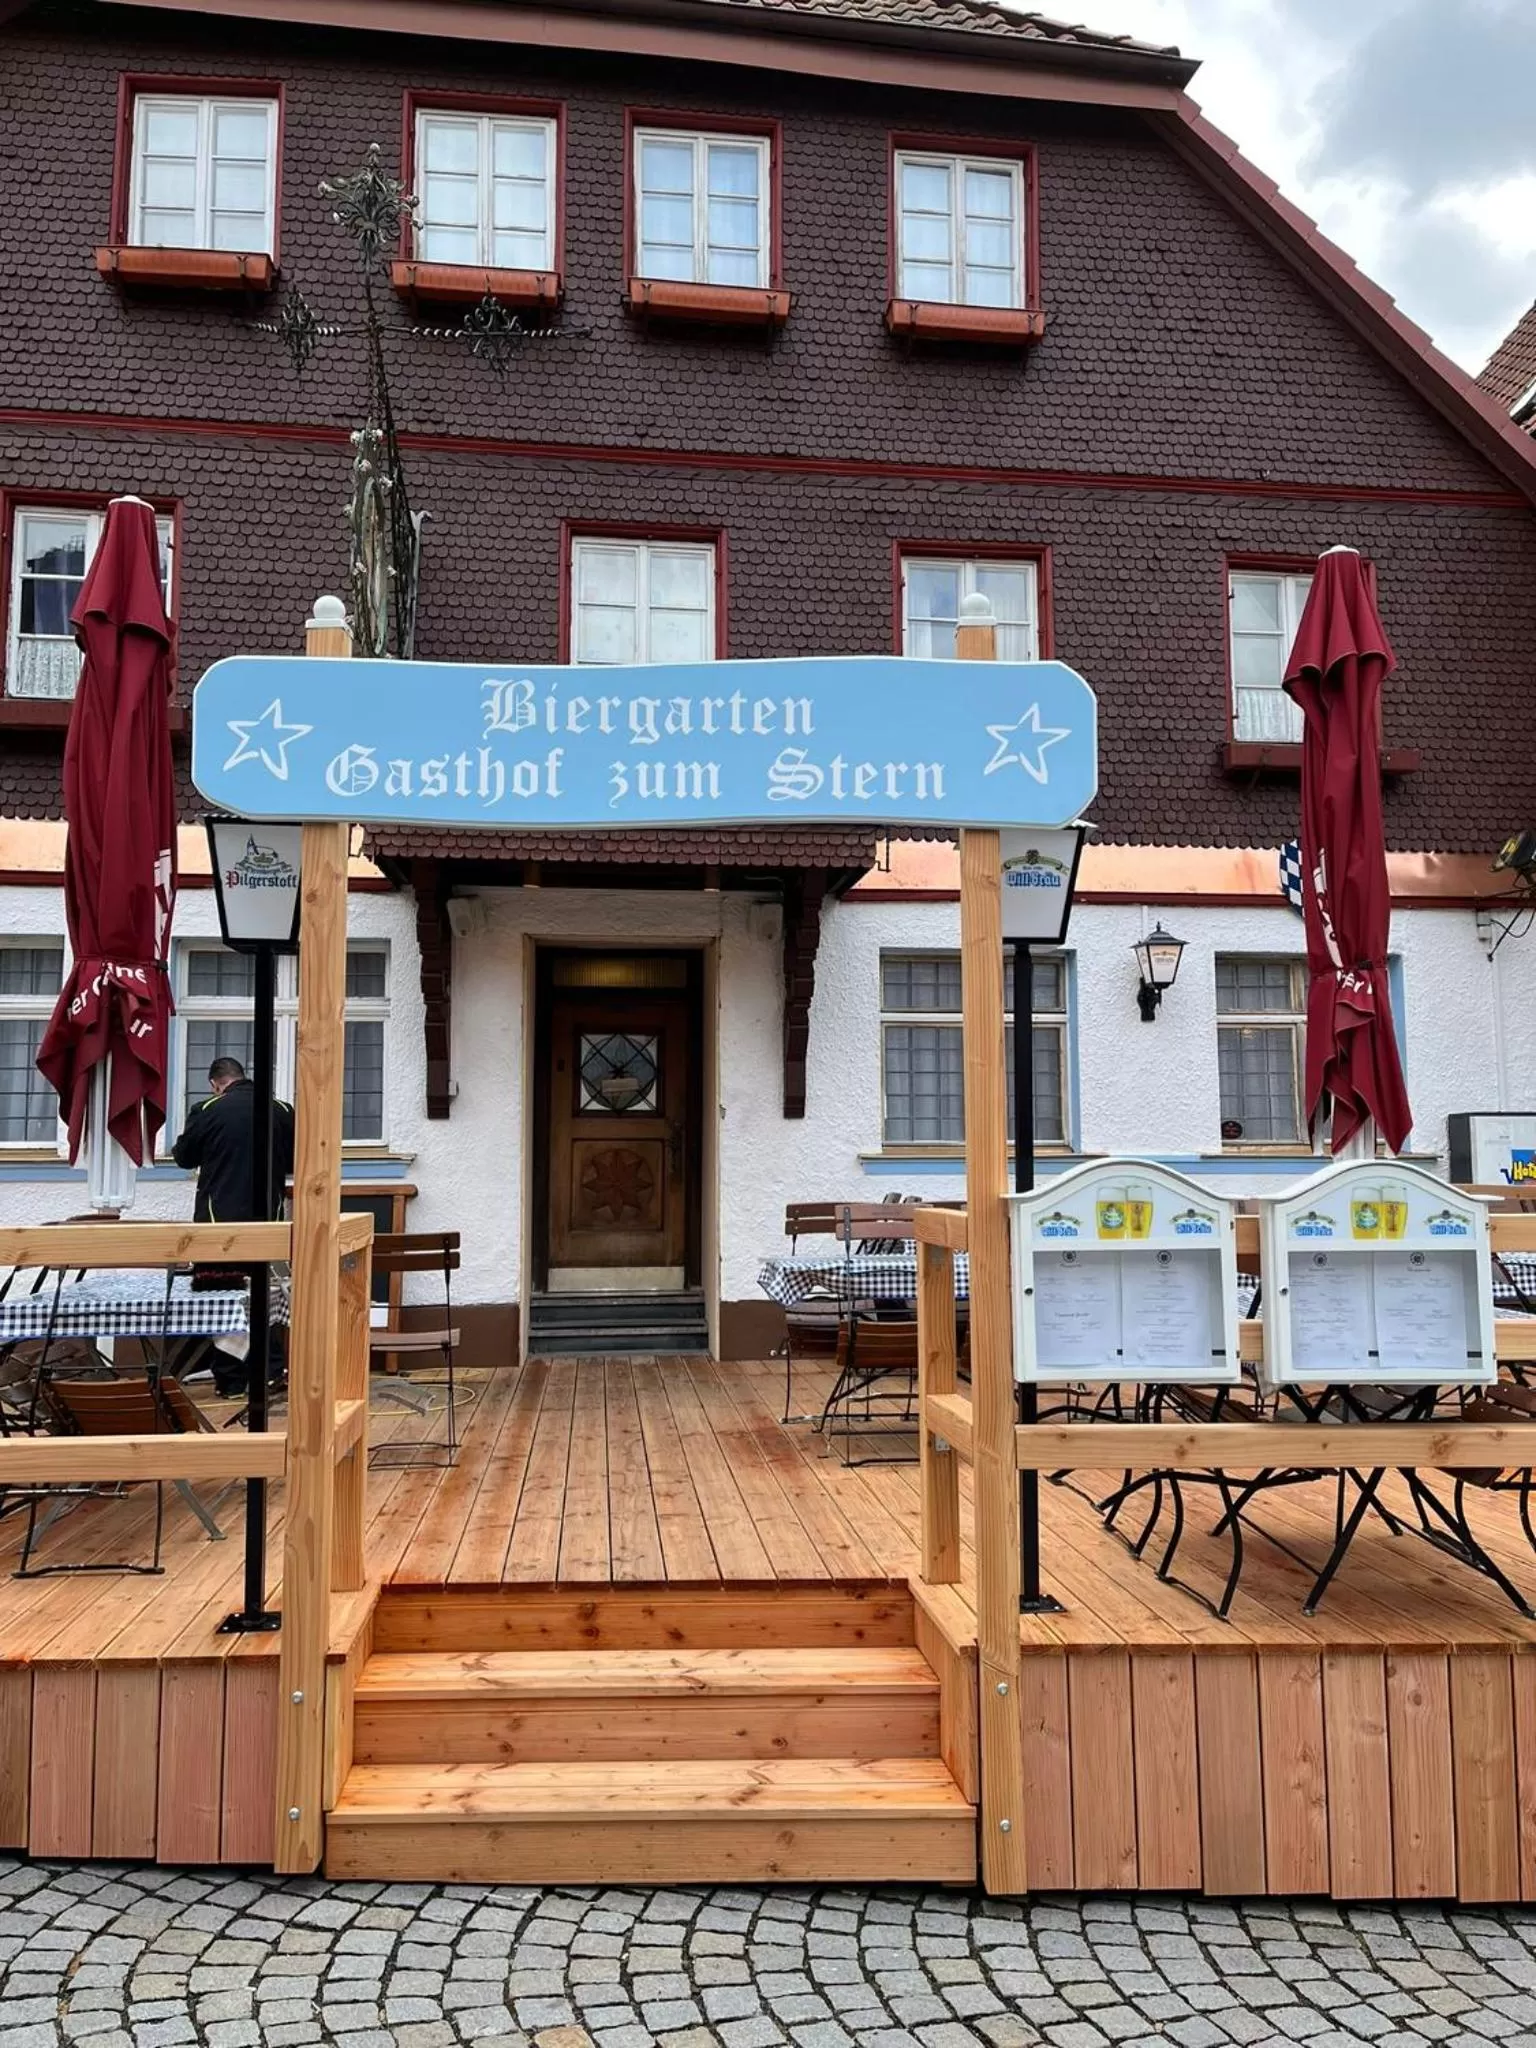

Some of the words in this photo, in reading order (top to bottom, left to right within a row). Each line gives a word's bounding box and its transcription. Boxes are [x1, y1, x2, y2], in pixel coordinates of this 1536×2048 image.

[479, 678, 816, 745] Biergarten
[324, 742, 565, 808] Gasthof
[607, 760, 722, 809] zum
[766, 746, 947, 801] Stern
[225, 870, 297, 889] Pilgerstoff
